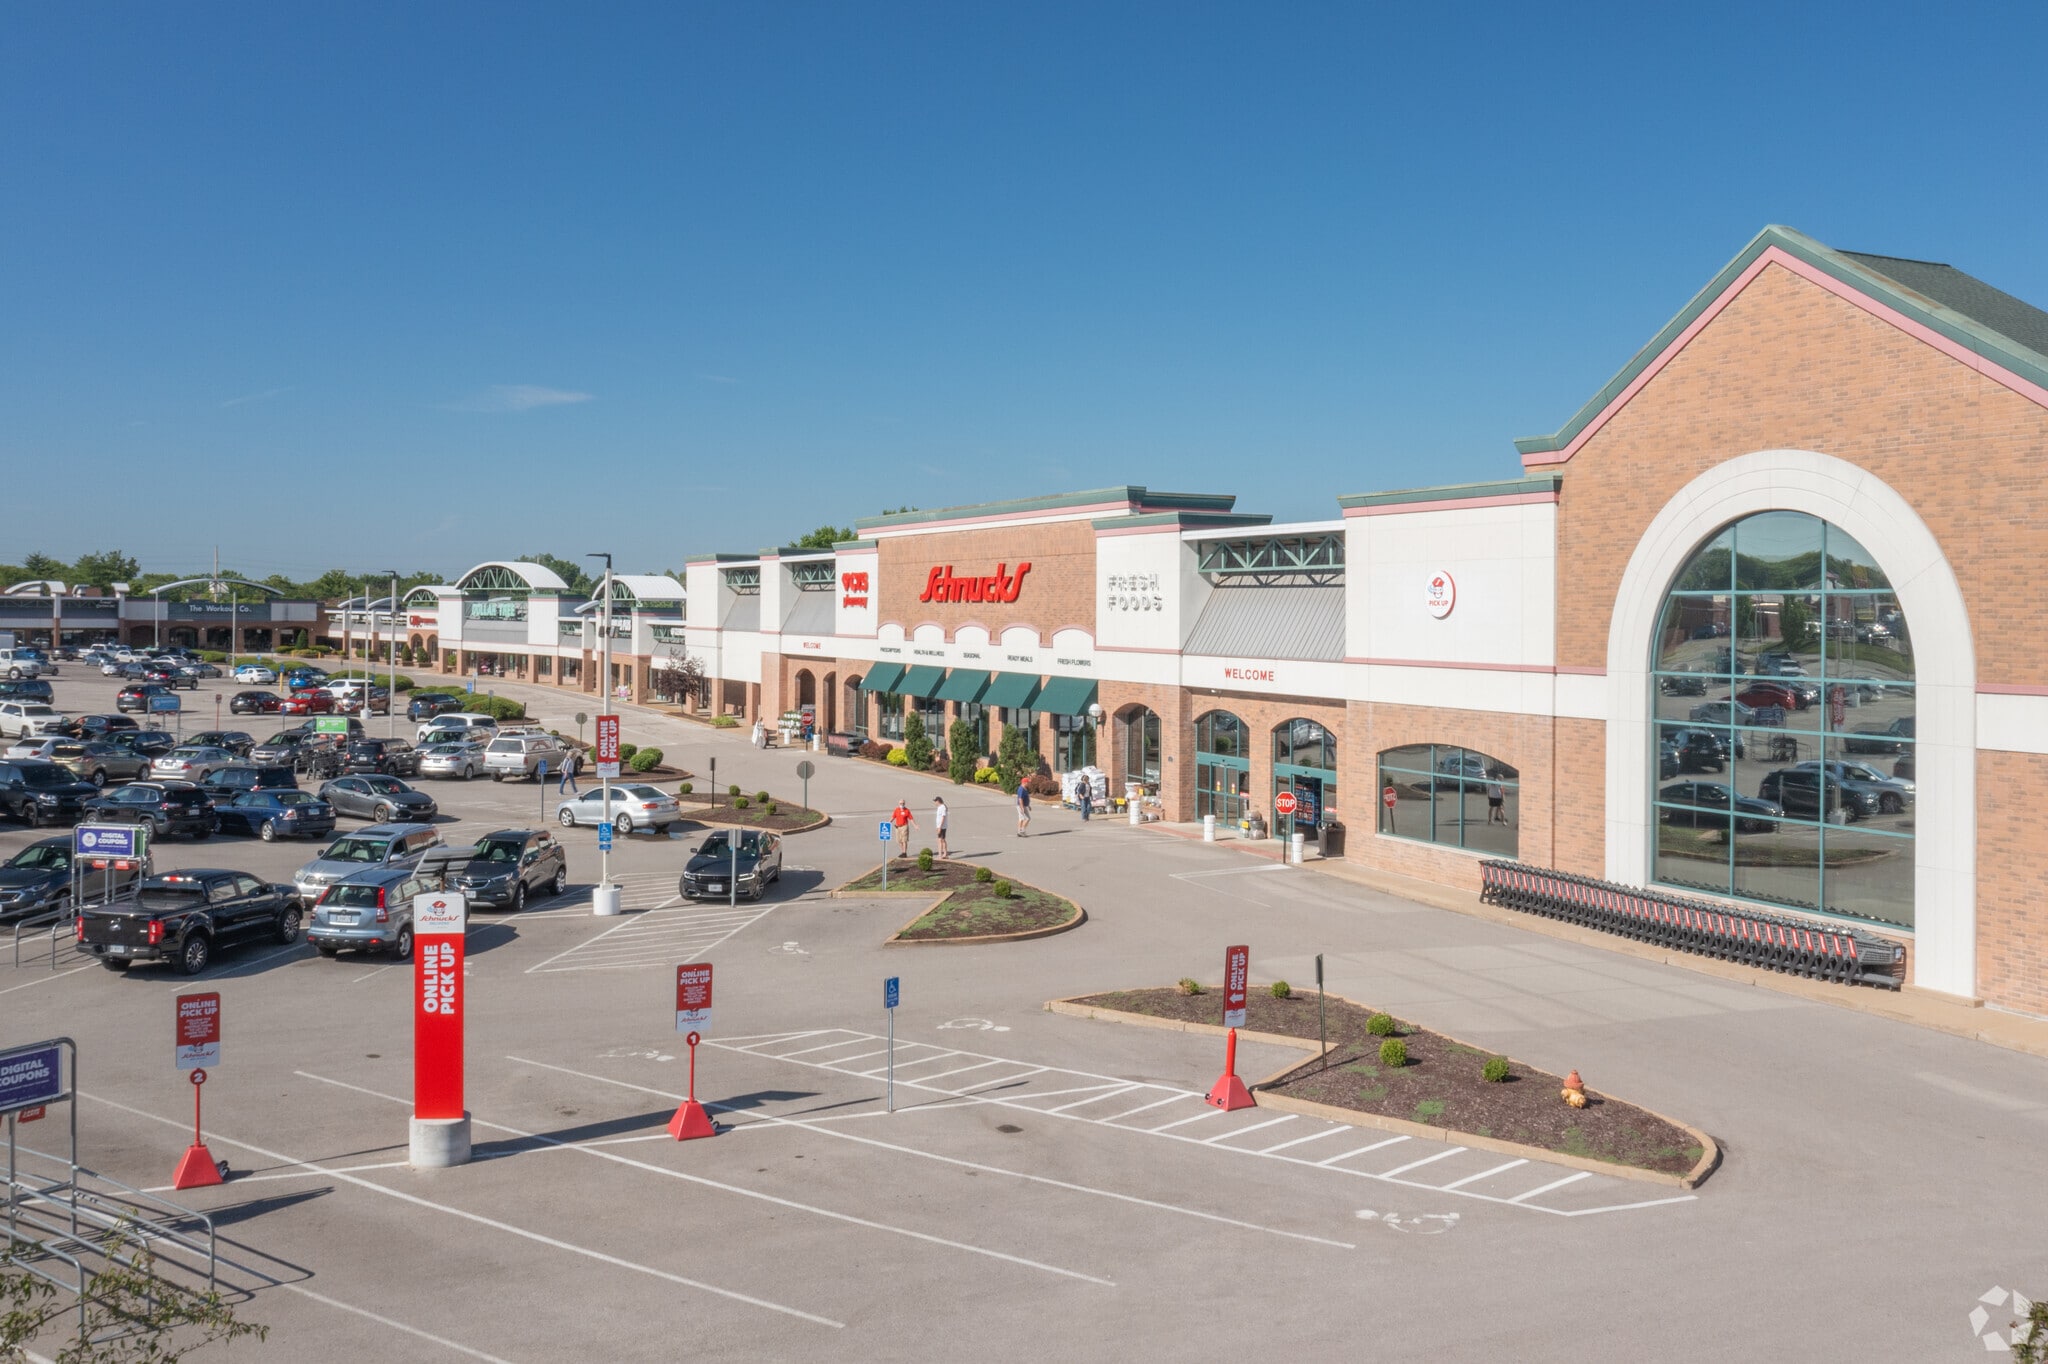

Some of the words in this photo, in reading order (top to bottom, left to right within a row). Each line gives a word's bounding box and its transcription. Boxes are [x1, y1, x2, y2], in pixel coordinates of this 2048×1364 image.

[1108, 574, 1160, 591] FRESH
[189, 604, 202, 612] The
[205, 604, 234, 612] Workou
[239, 604, 252, 613] Co.
[1108, 594, 1162, 612] FOODS
[1224, 667, 1275, 681] WELCOME
[609, 720, 617, 733] UP
[600, 721, 608, 757] ONLINE
[609, 735, 617, 758] PICK
[1276, 799, 1295, 808] STOP
[440, 942, 455, 968] UP
[1239, 952, 1246, 966] UP
[423, 945, 439, 1013] ONLINE
[681, 970, 710, 978] ONLINE
[1230, 954, 1238, 990] ONLINE
[1237, 968, 1245, 990] PICK
[440, 972, 455, 1015] PICK
[180, 1009, 202, 1017] PICK
[204, 1007, 217, 1015] UP
[181, 1000, 216, 1009] ONLINE
[690, 1035, 697, 1044] 1
[1, 1059, 44, 1076] DIGITAL
[0, 1067, 50, 1087] OUPONS
[193, 1072, 203, 1082] 2
